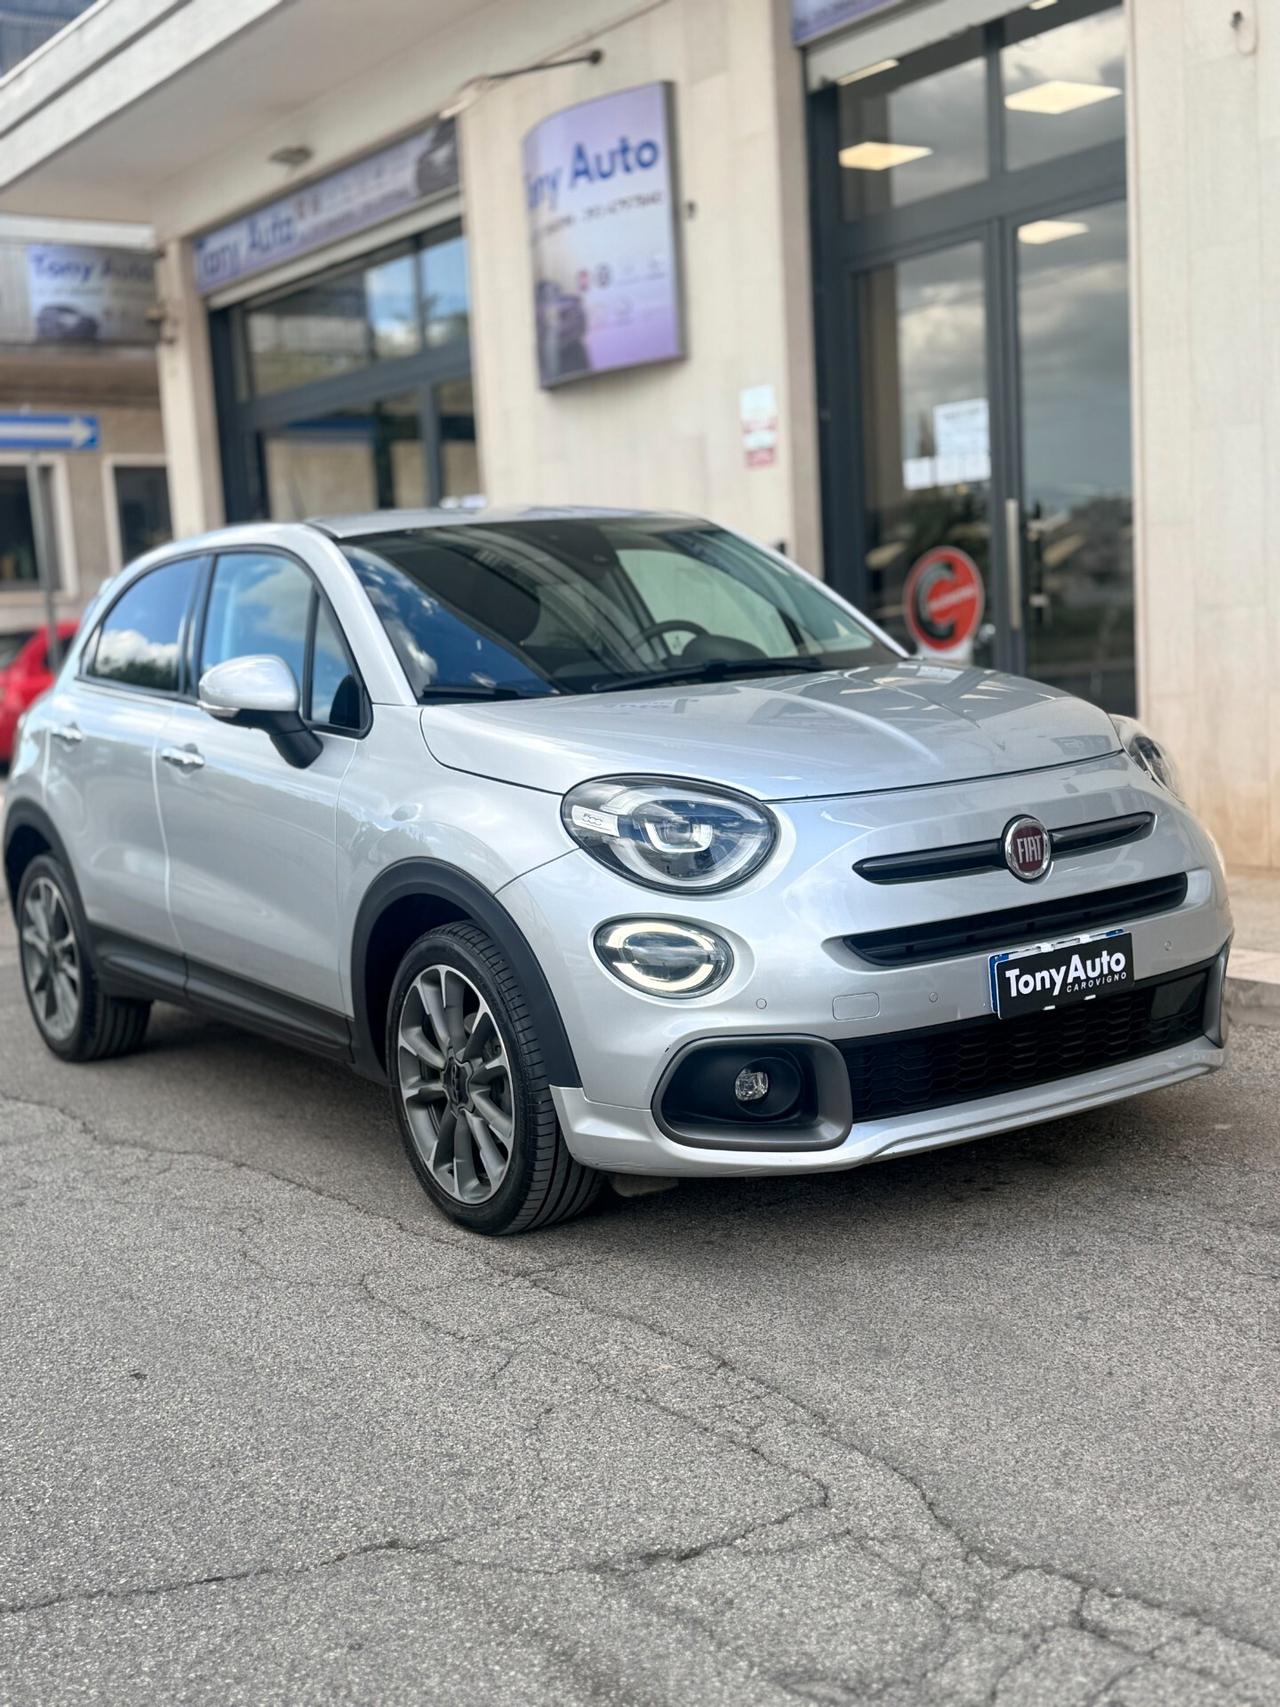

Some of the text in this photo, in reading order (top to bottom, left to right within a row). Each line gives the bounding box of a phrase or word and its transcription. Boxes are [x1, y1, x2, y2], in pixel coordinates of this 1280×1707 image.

[569, 136, 659, 188] Auto
[1016, 835, 1042, 864] FIAT
[1066, 971, 1127, 993] CAROVIGNO
